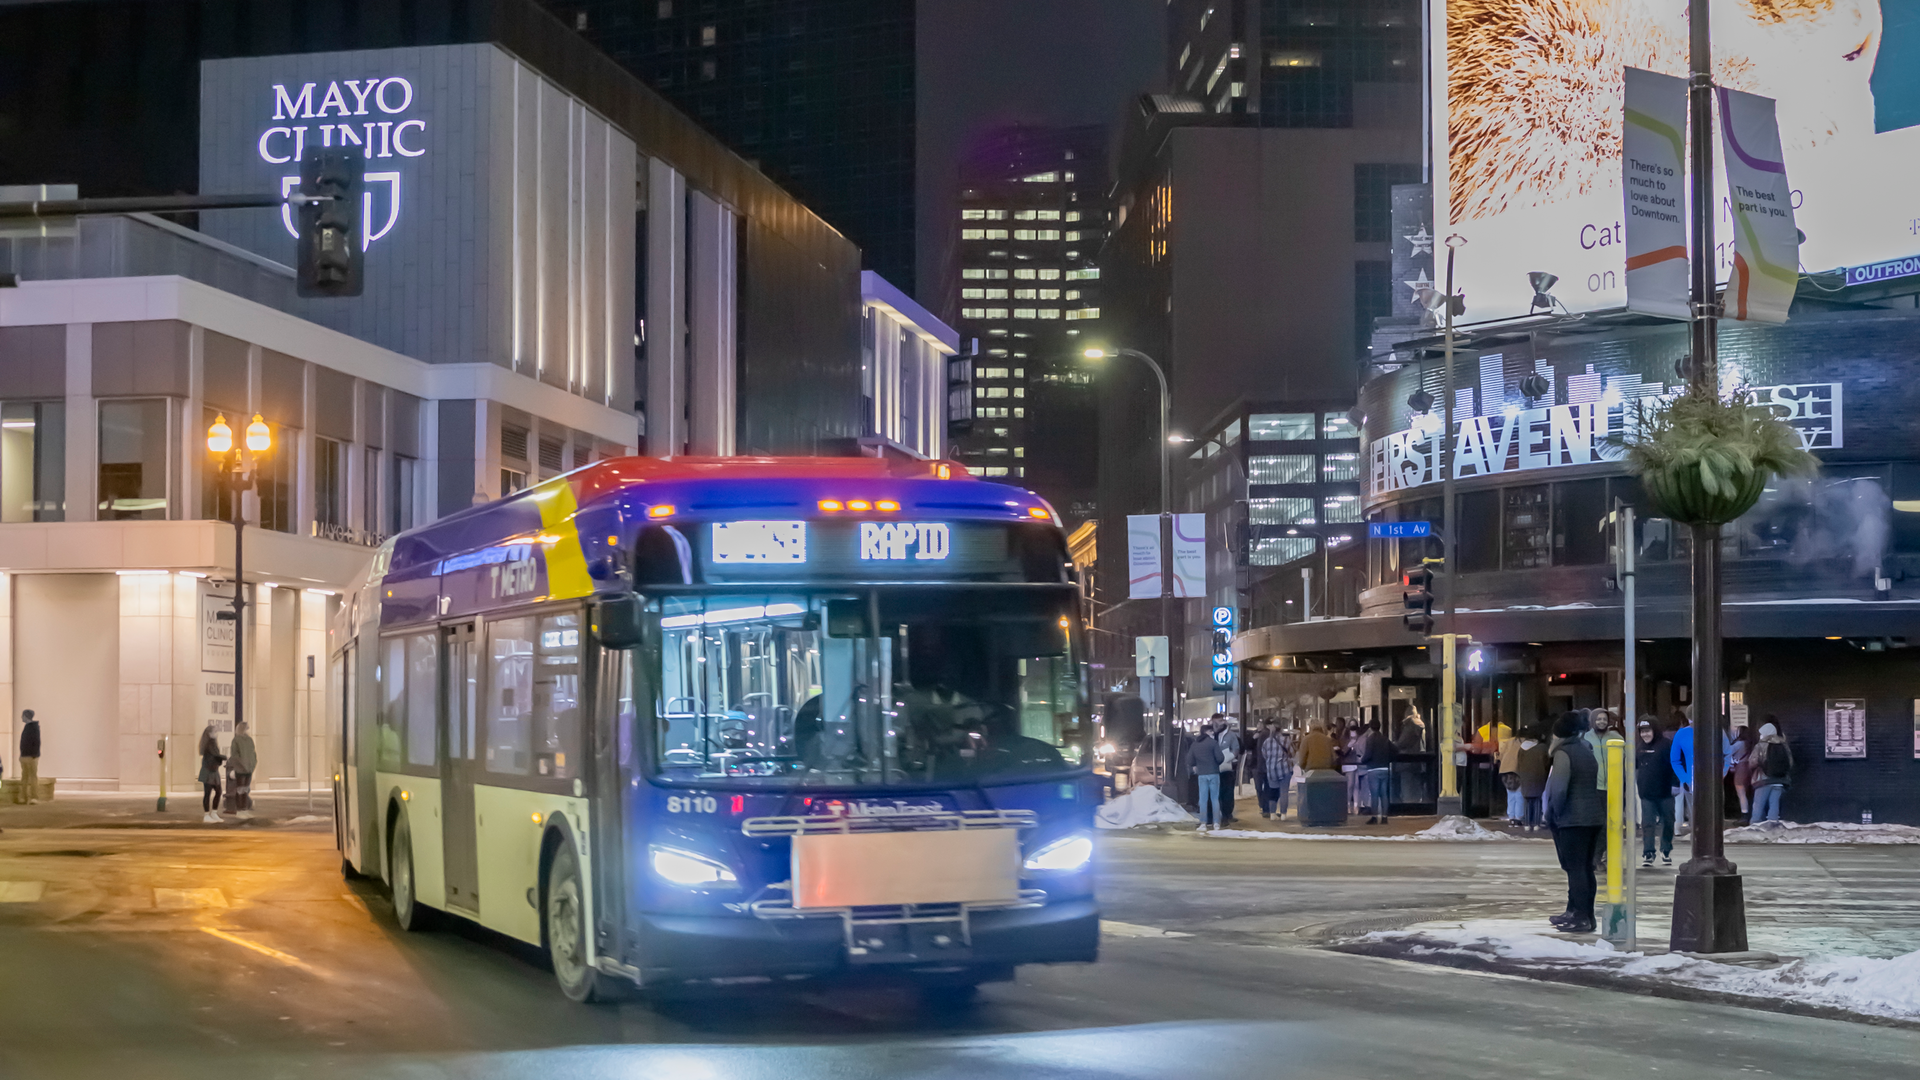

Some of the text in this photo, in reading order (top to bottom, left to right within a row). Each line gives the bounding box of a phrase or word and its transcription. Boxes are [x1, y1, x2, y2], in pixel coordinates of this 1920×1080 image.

[272, 77, 413, 120] MAYO
[1630, 158, 1674, 177] There's so
[1630, 176, 1666, 191] much to
[1735, 185, 1776, 202] The best
[1630, 189, 1676, 208] love about
[1631, 204, 1680, 224] Downtown.
[1738, 202, 1788, 218] part is you.
[1580, 220, 1622, 250] Cat
[1587, 270, 1616, 292] on
[1770, 384, 1822, 422] St
[1372, 421, 1446, 496] FIRST
[1373, 524, 1426, 535] N 1st Av
[860, 522, 950, 560] RAPID
[500, 556, 538, 597] METRO
[667, 795, 718, 814] 8110
